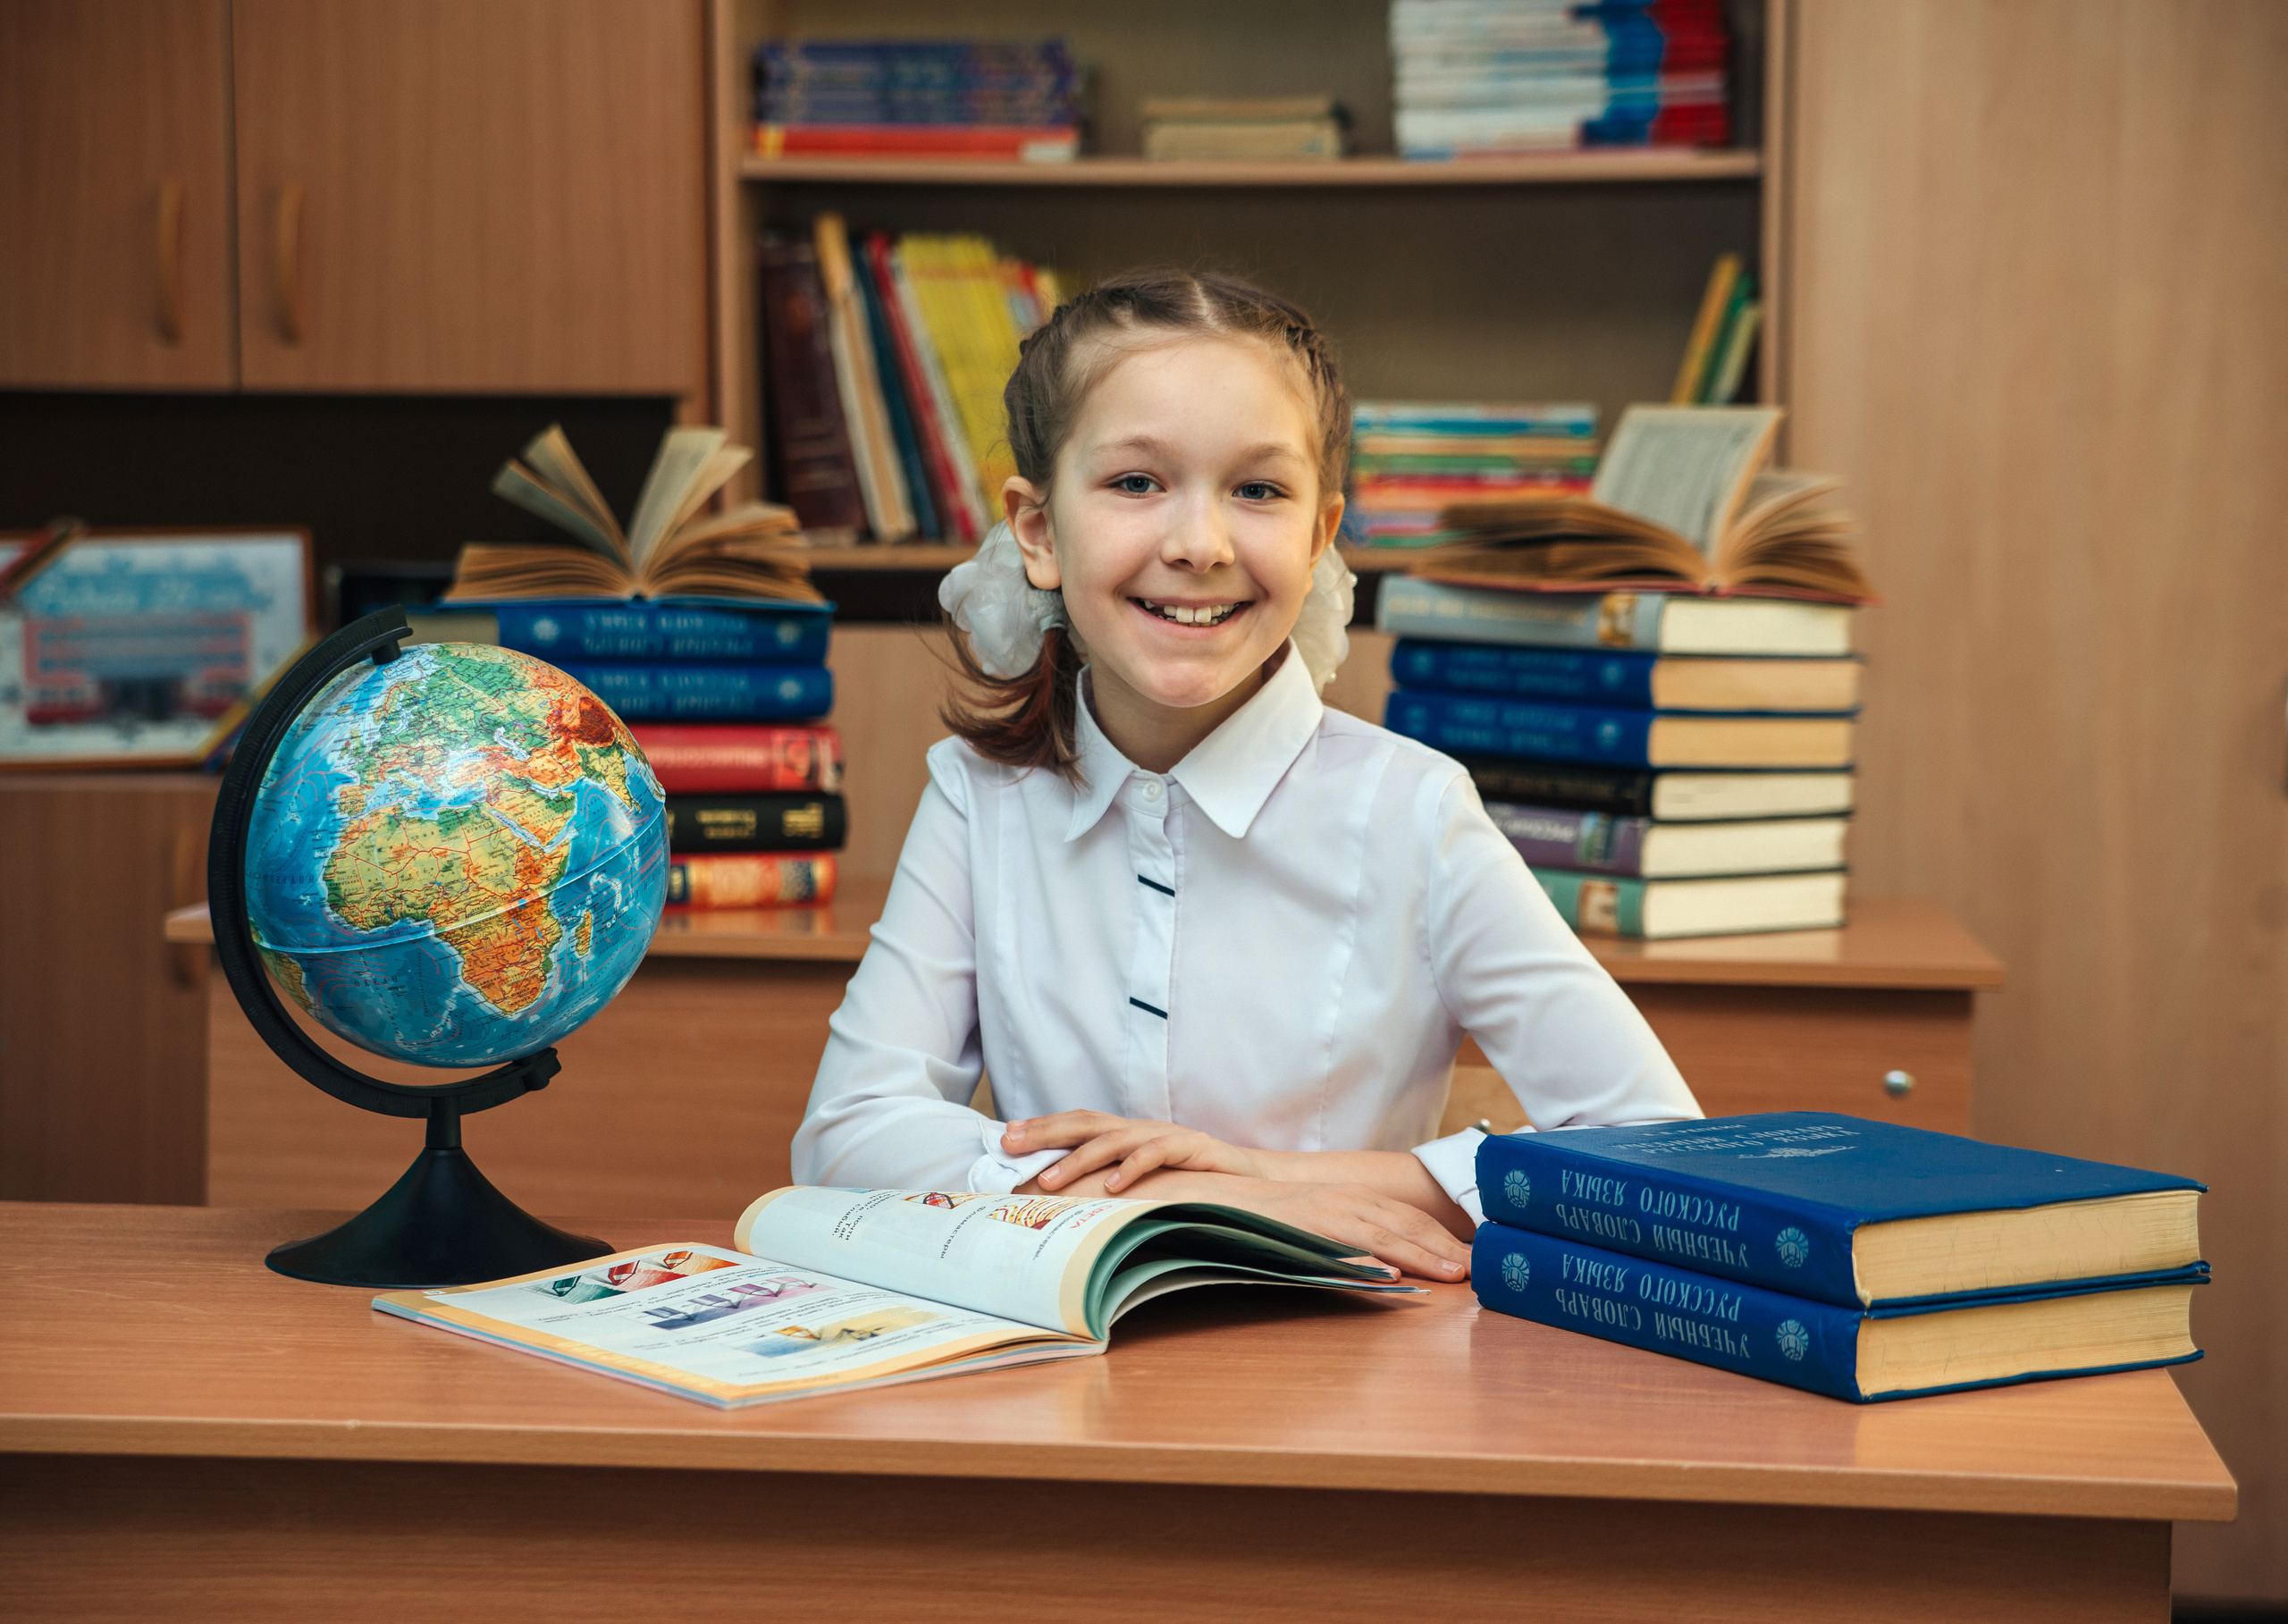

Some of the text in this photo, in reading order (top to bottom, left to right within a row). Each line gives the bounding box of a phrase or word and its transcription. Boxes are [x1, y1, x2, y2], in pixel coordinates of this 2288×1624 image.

[1640, 1130, 1861, 1154] РУССКОГО ЯЗЫКА
[1734, 1124, 1844, 1140] СЛОВАРЬ
[1562, 1169, 1740, 1232] РУССКОГО ЯЗЫКА
[832, 1203, 861, 1236] слабый.
[838, 1222, 852, 1239] Так
[845, 1216, 863, 1241] почти
[1556, 1203, 1748, 1268] УЧЕБНЫЙ СЛОВАРЬ
[1563, 1253, 1742, 1322] РУССКОГО ЯЗЫКА
[1555, 1288, 1750, 1359] УЧЕБНЫЙ СЛОВАРЬ
